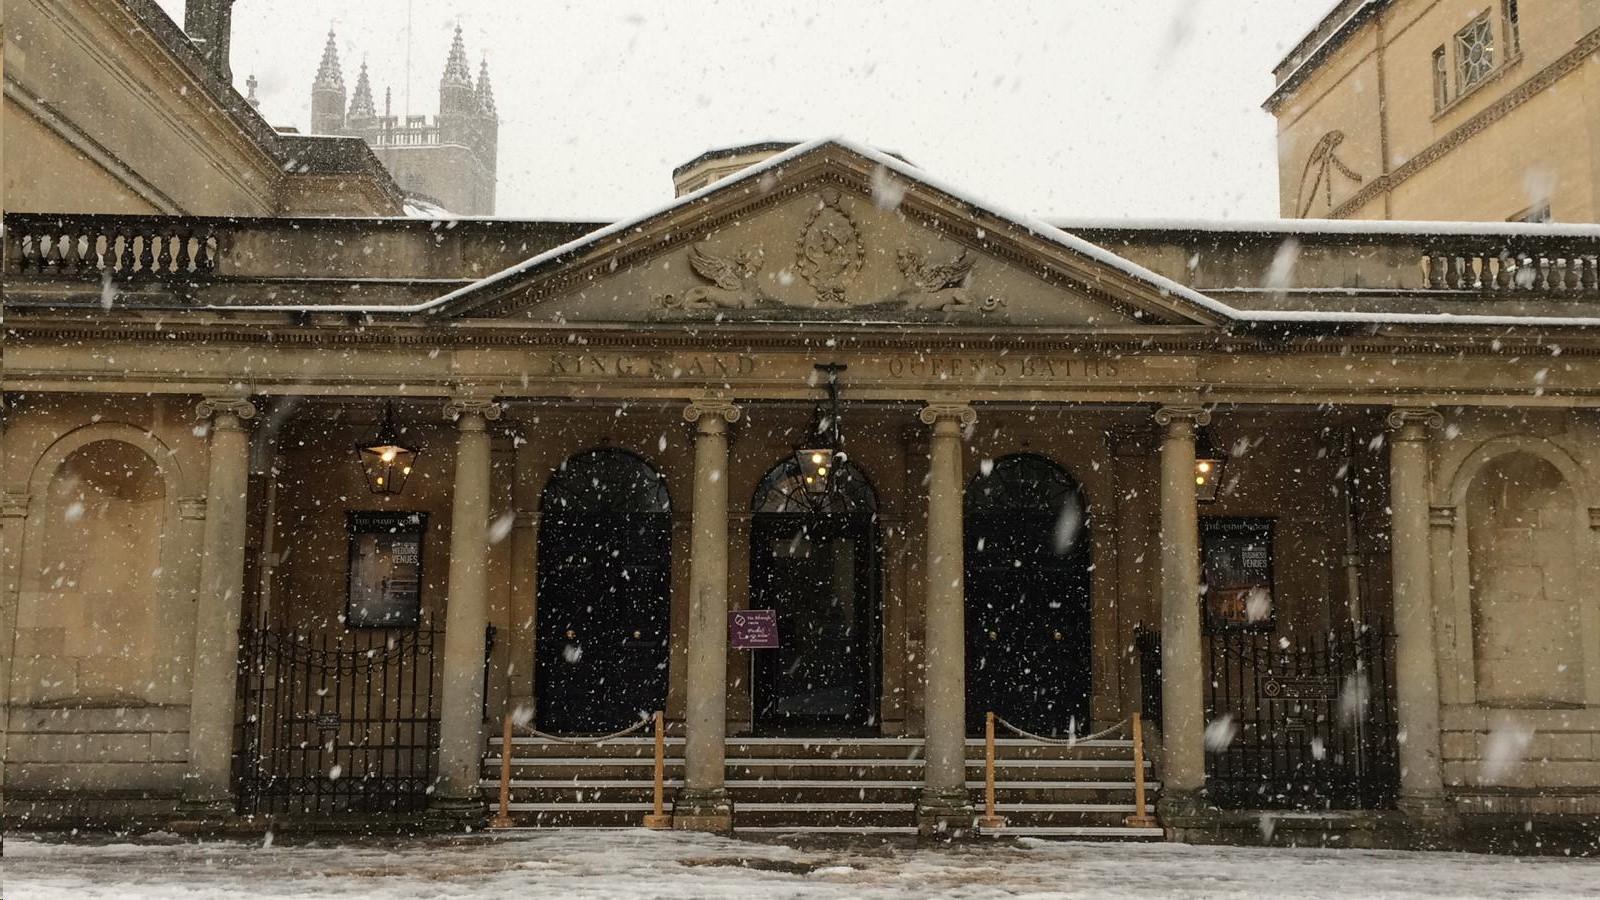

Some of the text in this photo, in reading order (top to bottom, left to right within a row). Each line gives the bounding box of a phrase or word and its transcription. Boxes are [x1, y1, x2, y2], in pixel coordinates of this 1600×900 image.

[550, 356, 663, 376] KINGS
[689, 356, 755, 375] AND
[1020, 358, 1119, 377] BATHS
[372, 518, 395, 526] PUMP
[392, 555, 418, 564] VENUES
[1242, 558, 1268, 568] VENUES
